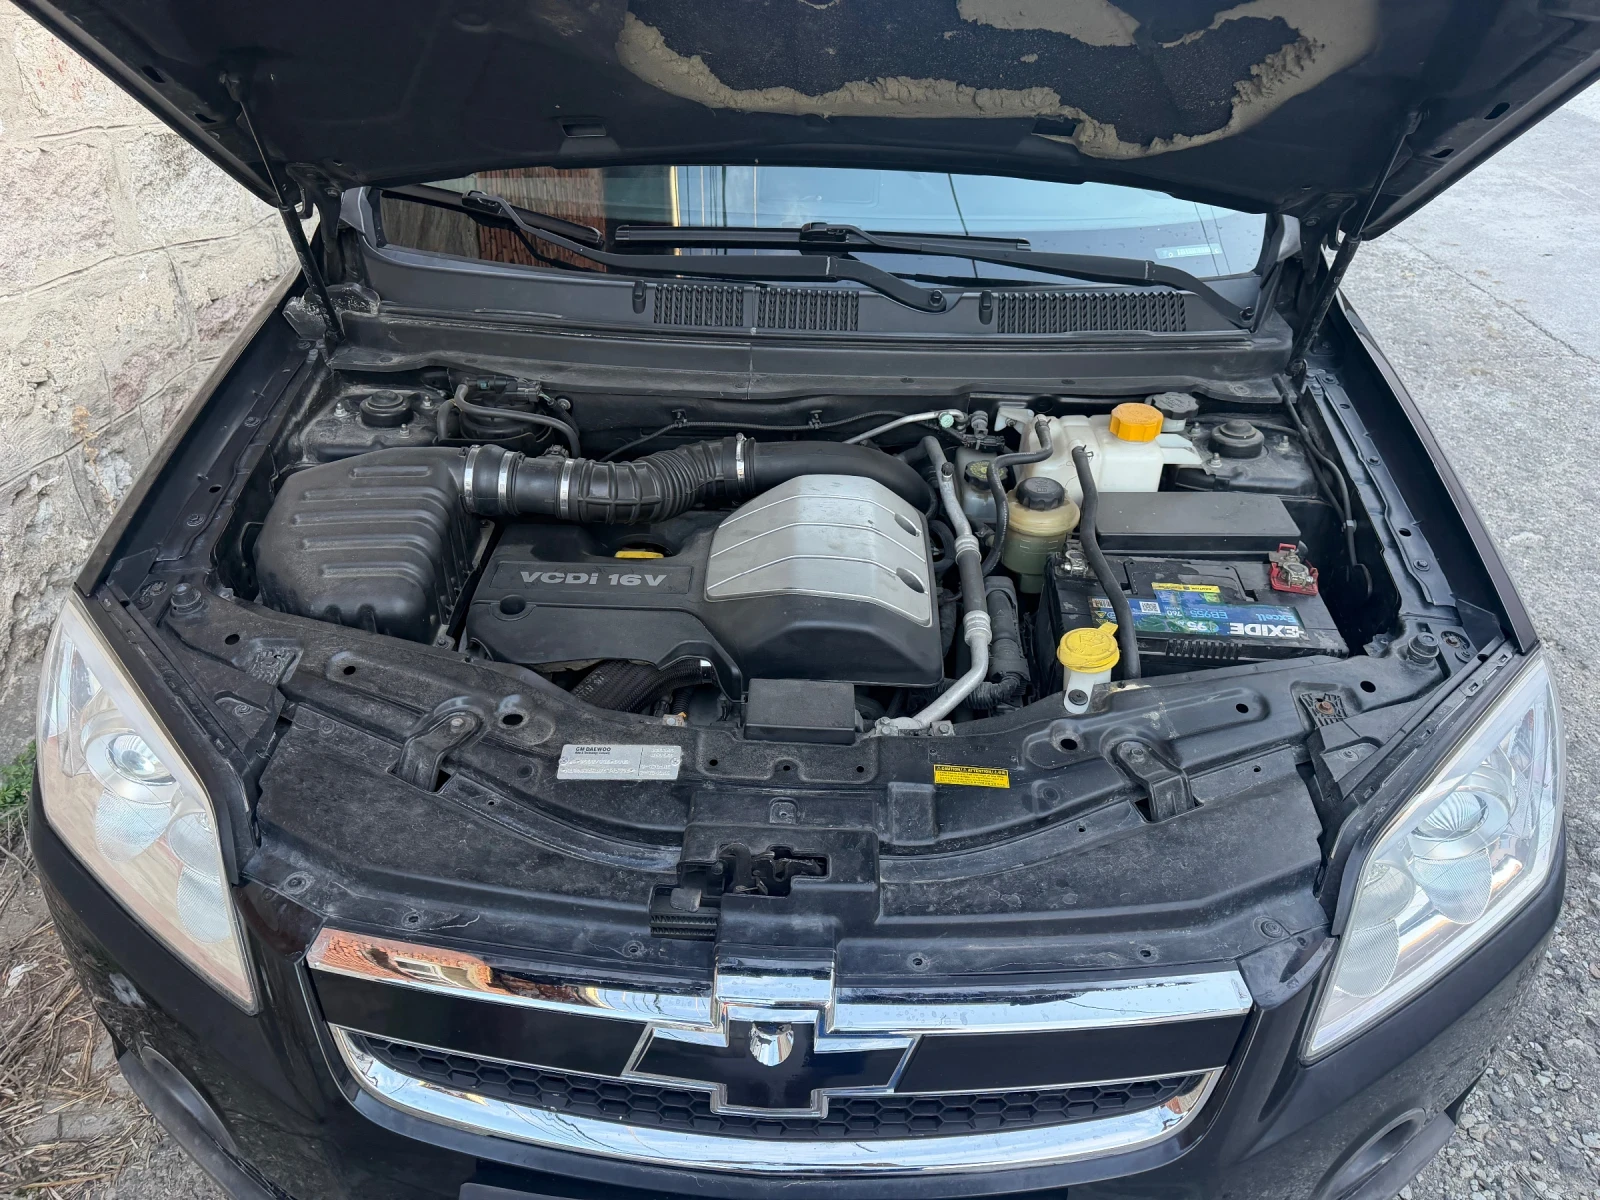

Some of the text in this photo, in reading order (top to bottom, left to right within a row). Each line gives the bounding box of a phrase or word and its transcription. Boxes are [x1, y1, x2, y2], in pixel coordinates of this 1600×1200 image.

[520, 571, 668, 587] VCDi 16V
[1190, 609, 1229, 619] EB955
[1256, 613, 1297, 623] Excell
[1186, 620, 1208, 631] 95
[1229, 622, 1304, 638] EXIDE
